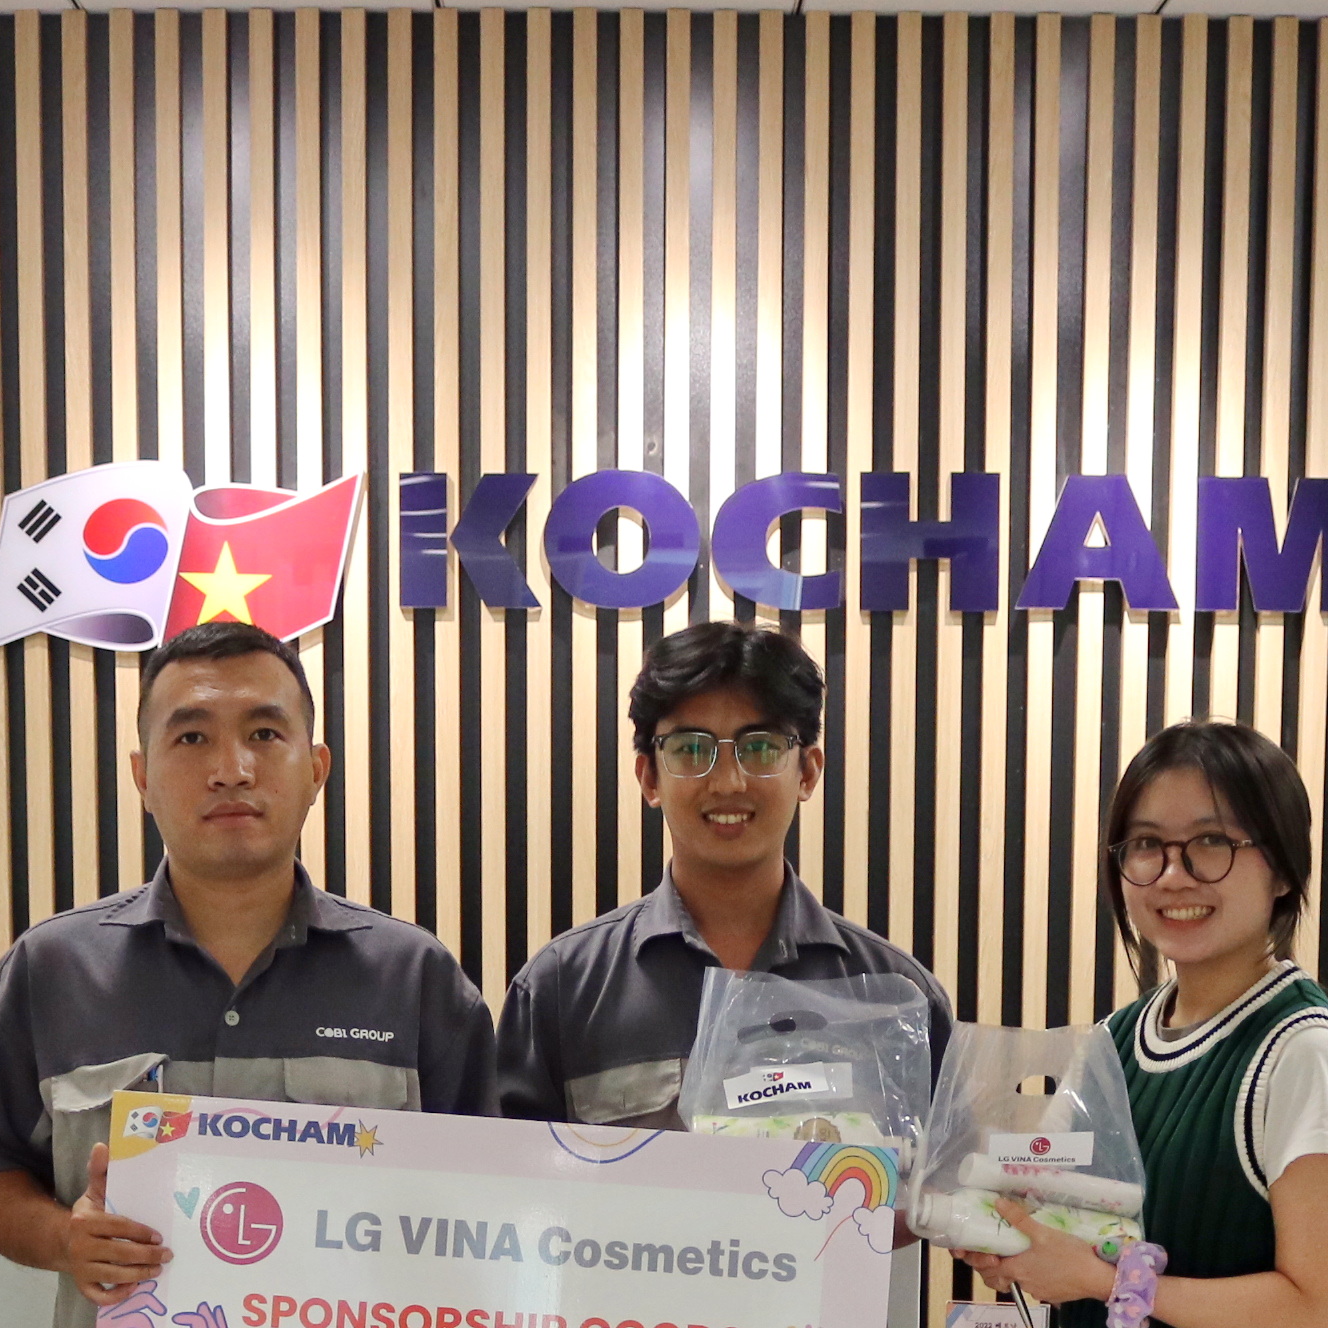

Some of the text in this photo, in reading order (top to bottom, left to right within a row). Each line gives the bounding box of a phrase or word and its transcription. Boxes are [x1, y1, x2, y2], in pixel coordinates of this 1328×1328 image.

[315, 1027, 394, 1042] COBI GROUP
[737, 1081, 812, 1103] KOCHAM
[198, 1112, 356, 1147] KOCHAM
[206, 1187, 277, 1260] LG
[314, 1209, 797, 1283] LG VINA Cosmetics
